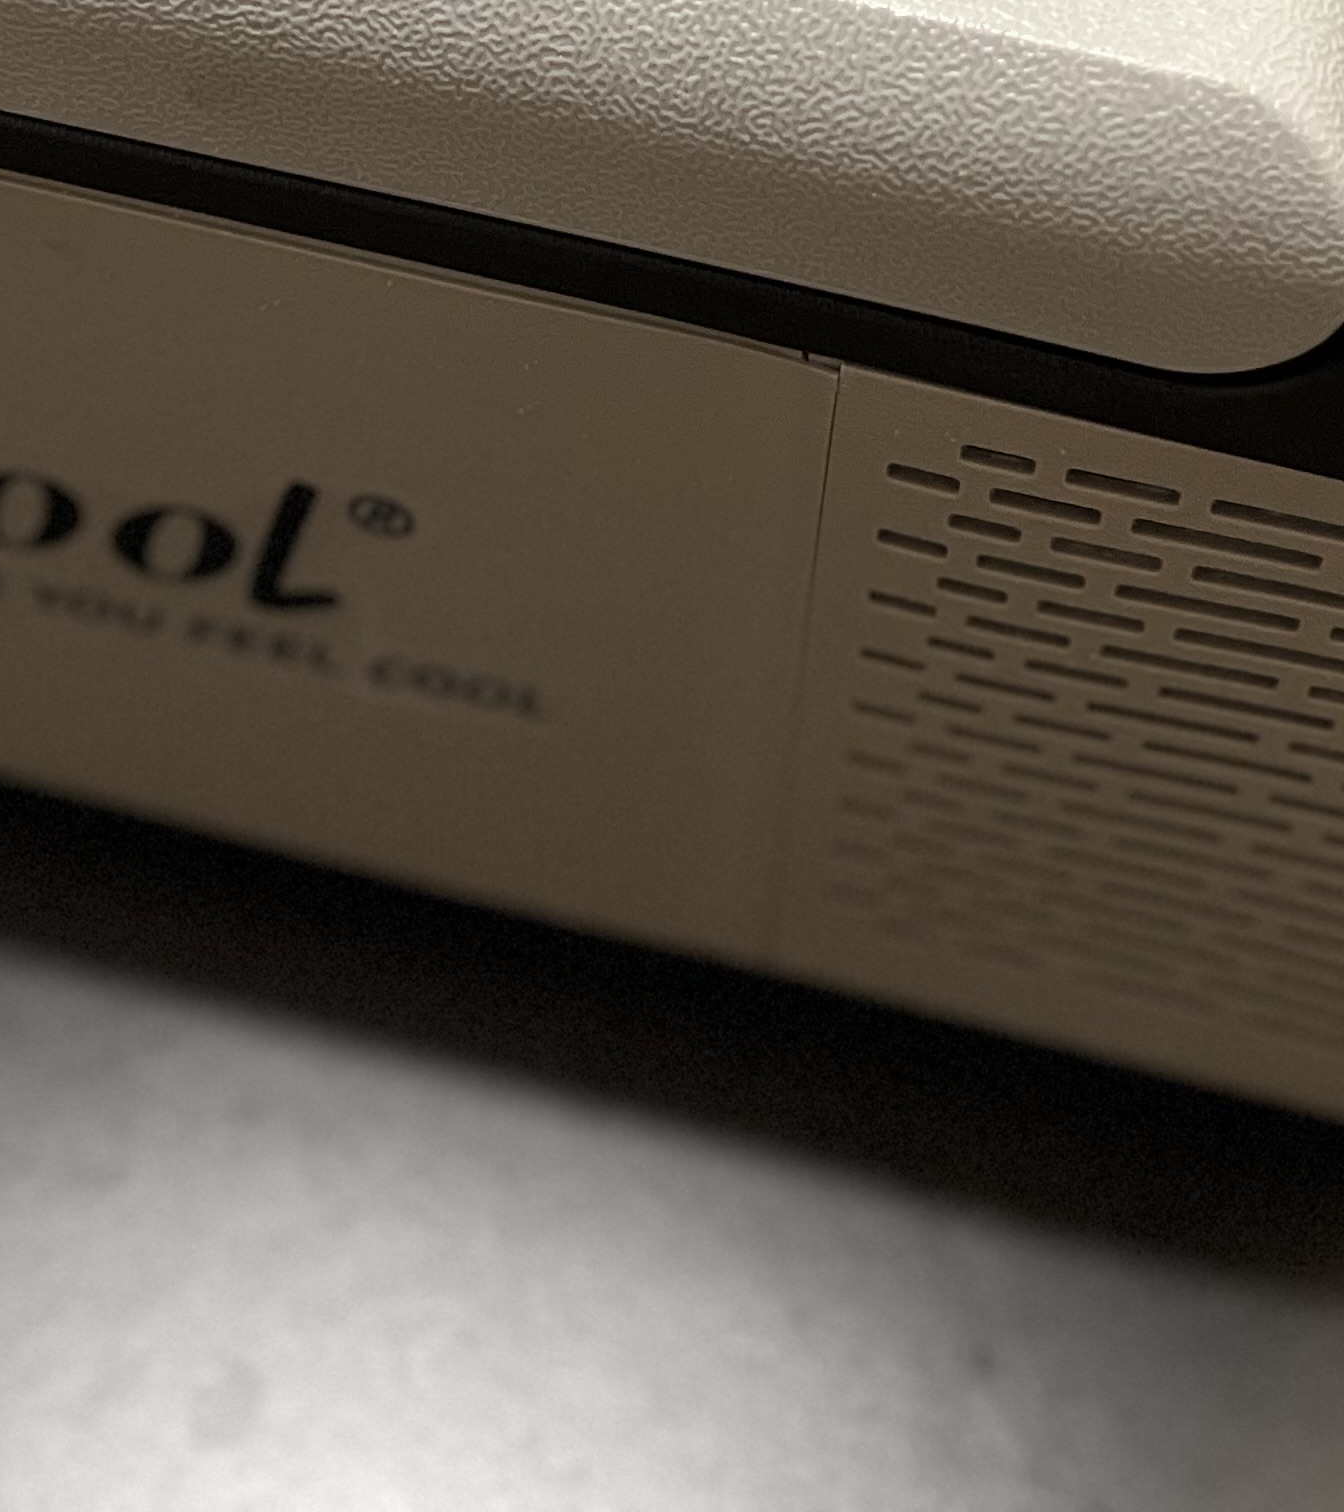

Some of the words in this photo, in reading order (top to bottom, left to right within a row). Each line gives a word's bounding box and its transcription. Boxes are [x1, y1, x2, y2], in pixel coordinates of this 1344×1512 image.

[32, 582, 166, 636] YOU
[186, 615, 340, 677] FEEL
[366, 650, 545, 718] COOL
